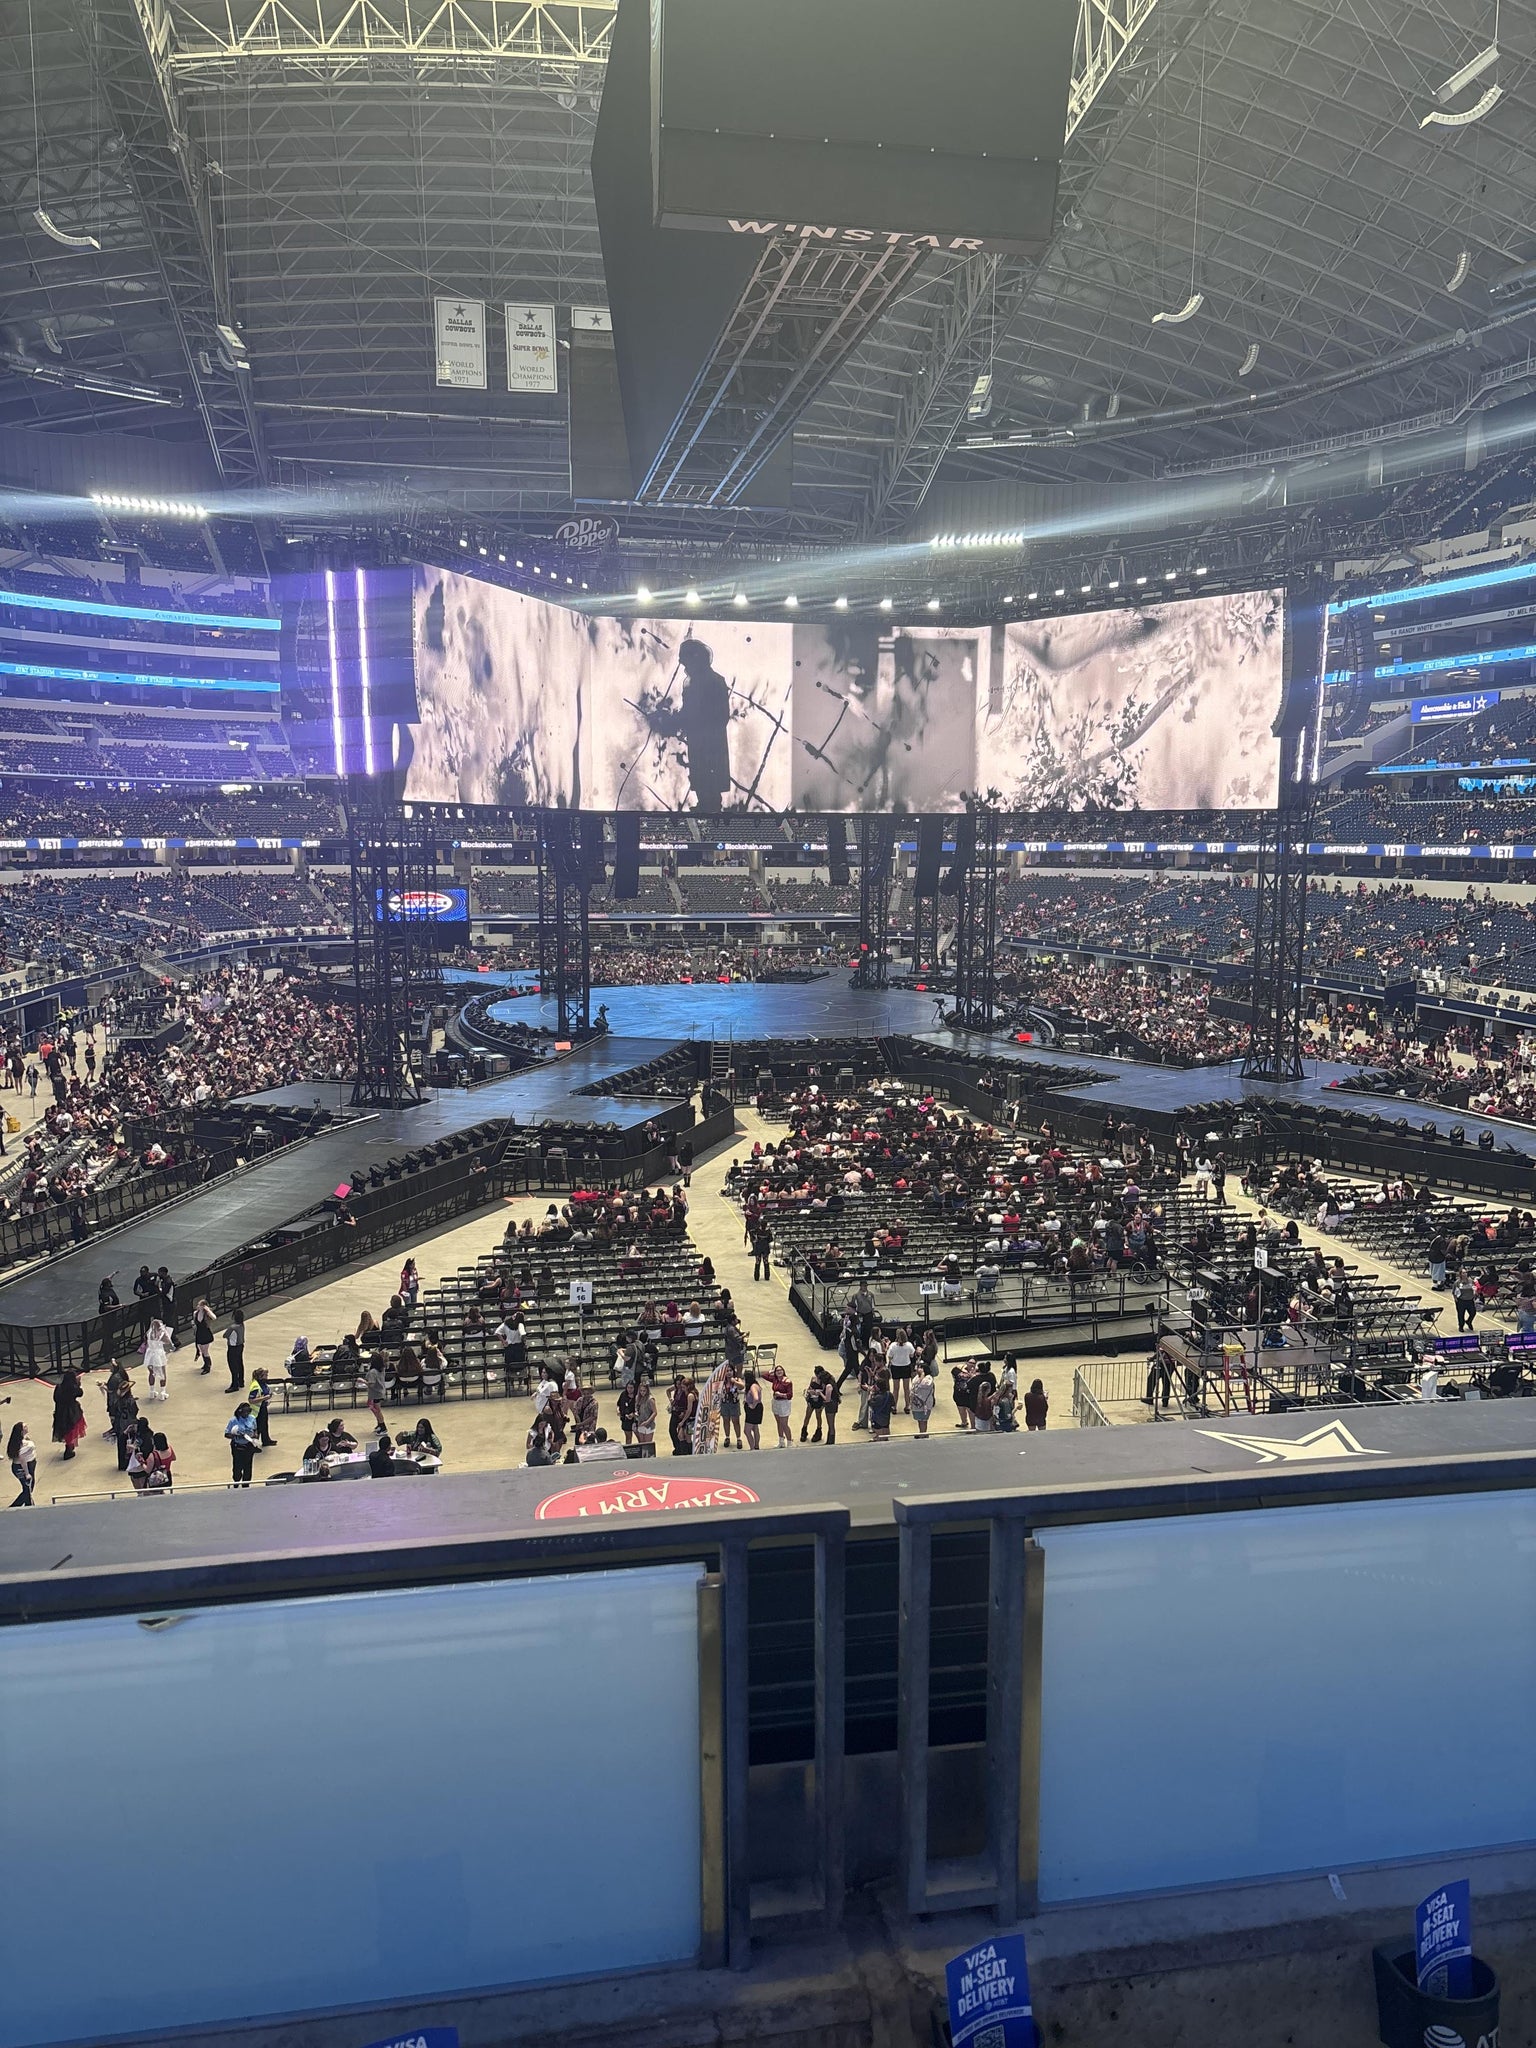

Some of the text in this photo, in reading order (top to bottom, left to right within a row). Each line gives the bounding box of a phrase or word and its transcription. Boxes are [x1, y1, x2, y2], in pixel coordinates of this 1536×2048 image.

[727, 219, 985, 250] WINSTAR
[448, 318, 472, 326] DALLAS
[518, 323, 543, 331] DALLAS
[445, 325, 475, 333] COWBOYS
[516, 330, 546, 338] COWBOYS
[520, 364, 545, 372] WORLD
[454, 376, 469, 384] 1971
[511, 372, 553, 380] CHAMPIONS
[525, 380, 541, 388] 1977
[579, 518, 602, 536] Dr
[1417, 623, 1433, 632] WHITE
[38, 838, 61, 849] YETI
[141, 838, 166, 849] YETI
[256, 838, 282, 849] YETI
[1024, 842, 1047, 852] YETI
[1124, 842, 1145, 852] YETI
[1206, 843, 1224, 853] YETI
[1384, 845, 1405, 856] YETI
[1489, 845, 1514, 858] YETI
[1426, 1892, 1448, 1914] VISA
[1422, 1904, 1455, 1938] IN-SEAT
[1420, 1920, 1461, 1959] DELIVERY
[965, 1945, 998, 1971] VISA
[961, 1958, 1008, 1995] IN-SEAT
[957, 1976, 1016, 2018] DELIVERY
